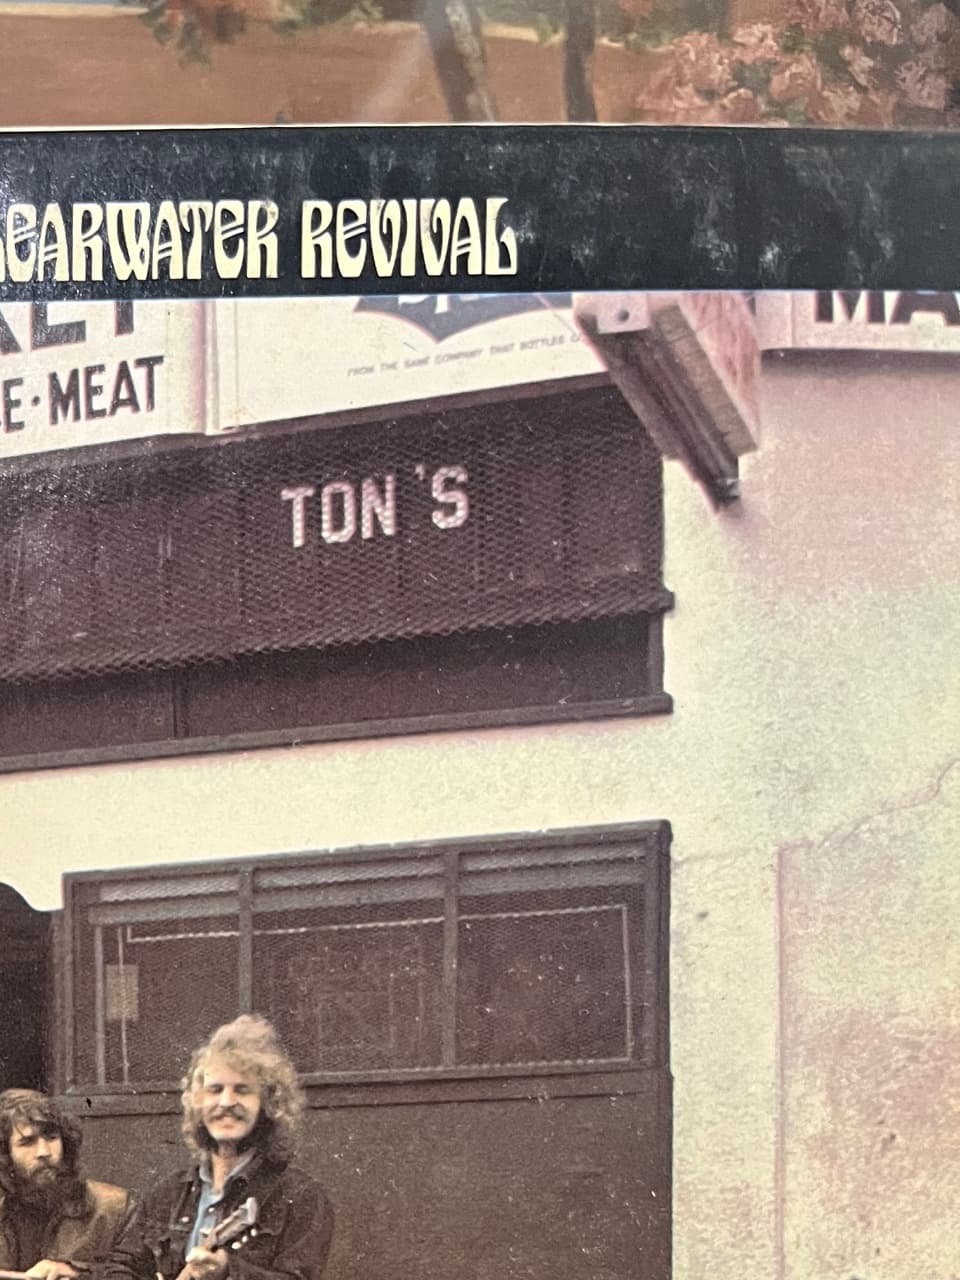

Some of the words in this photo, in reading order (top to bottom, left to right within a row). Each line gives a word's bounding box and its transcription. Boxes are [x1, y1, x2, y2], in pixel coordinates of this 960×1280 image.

[300, 197, 517, 279] REVIVAL
[48, 355, 165, 425] MEAT
[280, 474, 396, 548] TON
